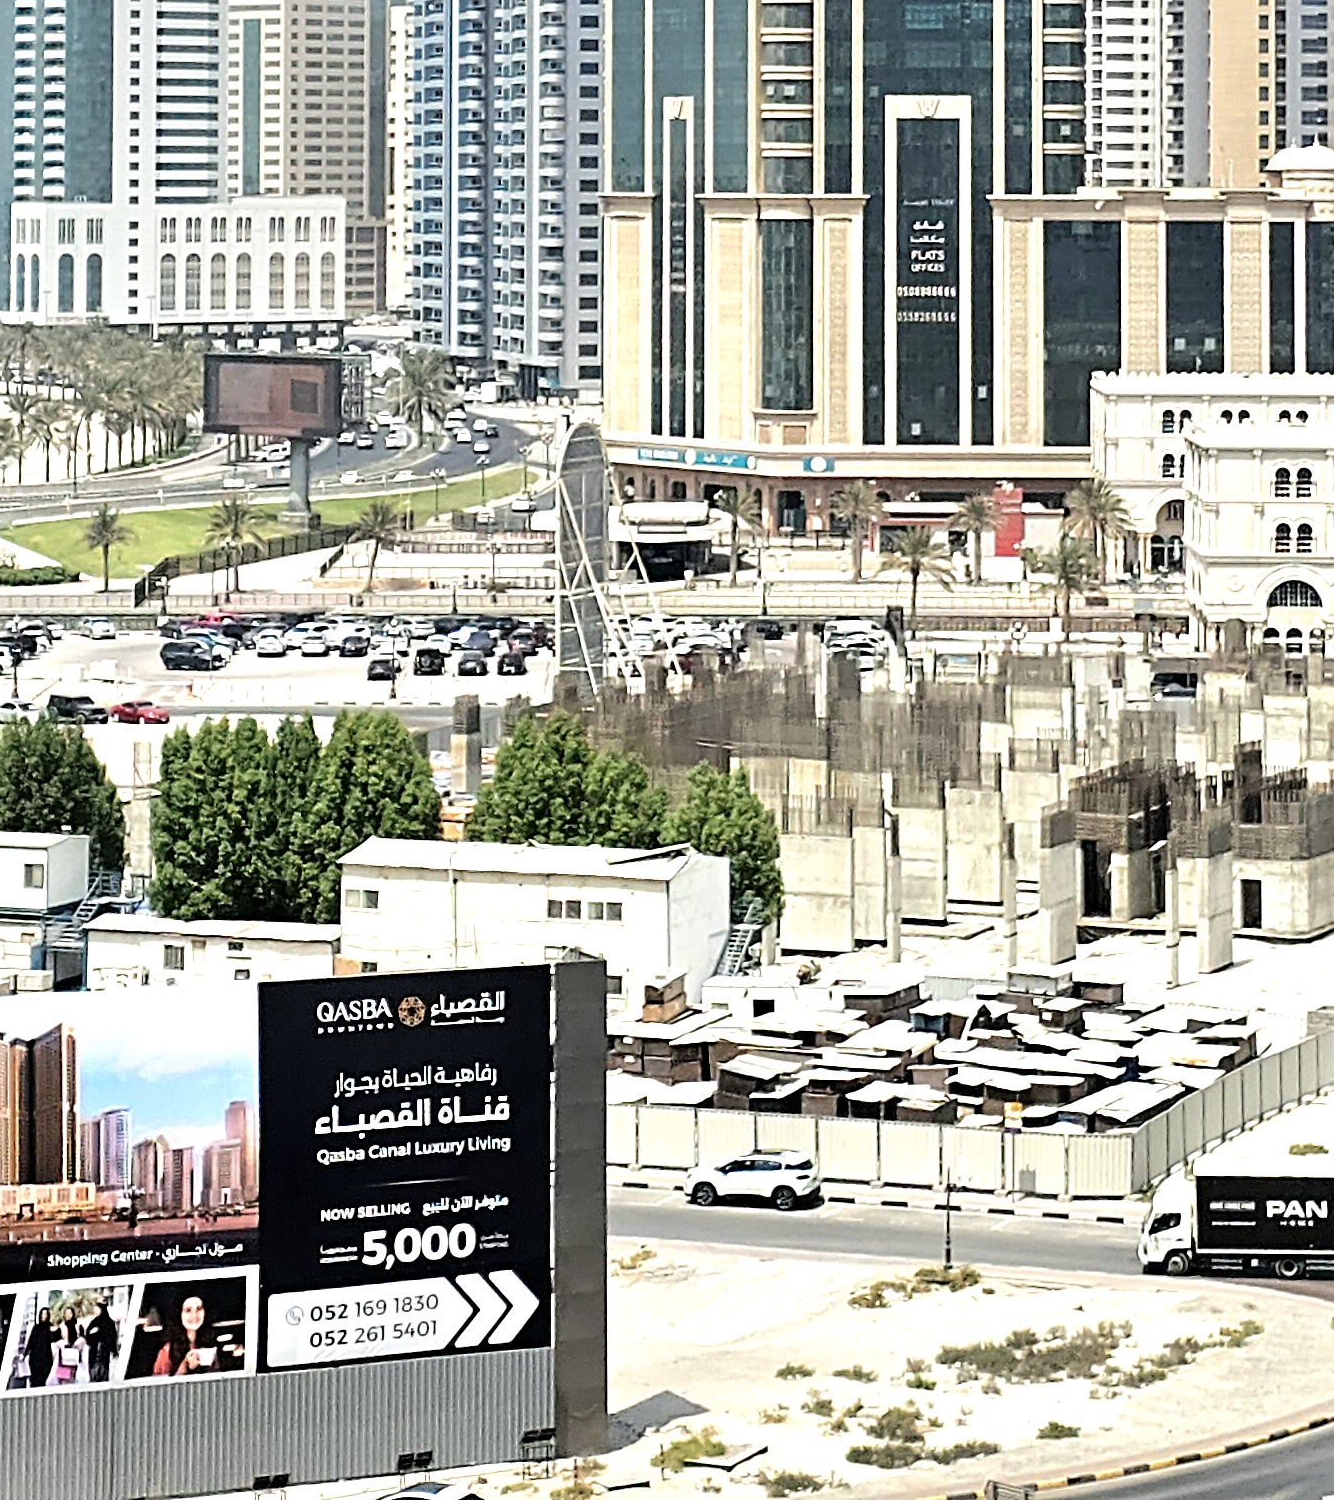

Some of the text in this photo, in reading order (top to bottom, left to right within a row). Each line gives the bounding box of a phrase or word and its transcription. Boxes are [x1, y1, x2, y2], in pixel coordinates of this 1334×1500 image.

[316, 997, 393, 1023] QASBA
[430, 990, 505, 1018] القصباء
[333, 1061, 498, 1098] رفاهية الحياة بجوار
[314, 1095, 510, 1140] قناة القصباء
[316, 1135, 512, 1166] Qasba Canal Luxury Living
[320, 1202, 411, 1223] NOW SELLING
[1266, 1200, 1329, 1219] PAN
[46, 1253, 109, 1268] Shopping
[110, 1249, 154, 1263] Center
[362, 1223, 477, 1270] 5,000
[310, 1294, 439, 1322] 052 169 1830
[309, 1320, 437, 1348] 052 261 5401
